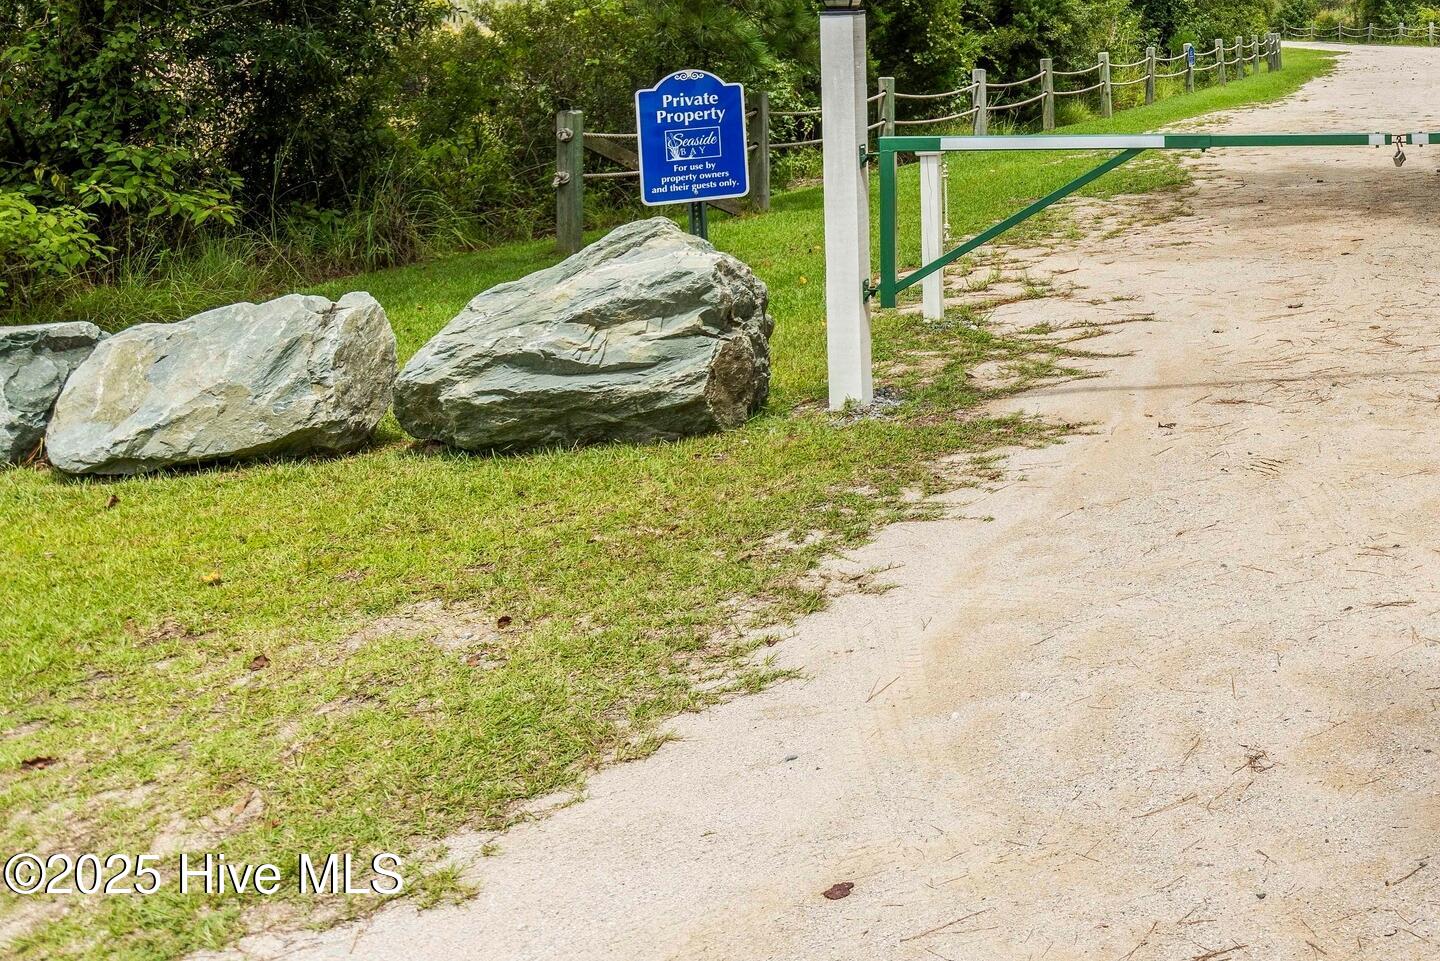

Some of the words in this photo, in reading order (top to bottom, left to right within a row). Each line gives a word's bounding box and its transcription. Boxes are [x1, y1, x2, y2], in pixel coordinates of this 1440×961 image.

[662, 92, 719, 108] Private
[656, 108, 725, 125] Property
[668, 131, 717, 148] Seaside
[680, 146, 706, 156] BAY
[673, 164, 687, 172] For
[706, 161, 716, 170] by
[661, 174, 697, 184] property
[700, 170, 729, 179] owners
[651, 185, 667, 194] and
[670, 183, 689, 192] their
[692, 180, 717, 192] guests
[719, 179, 739, 188] only.
